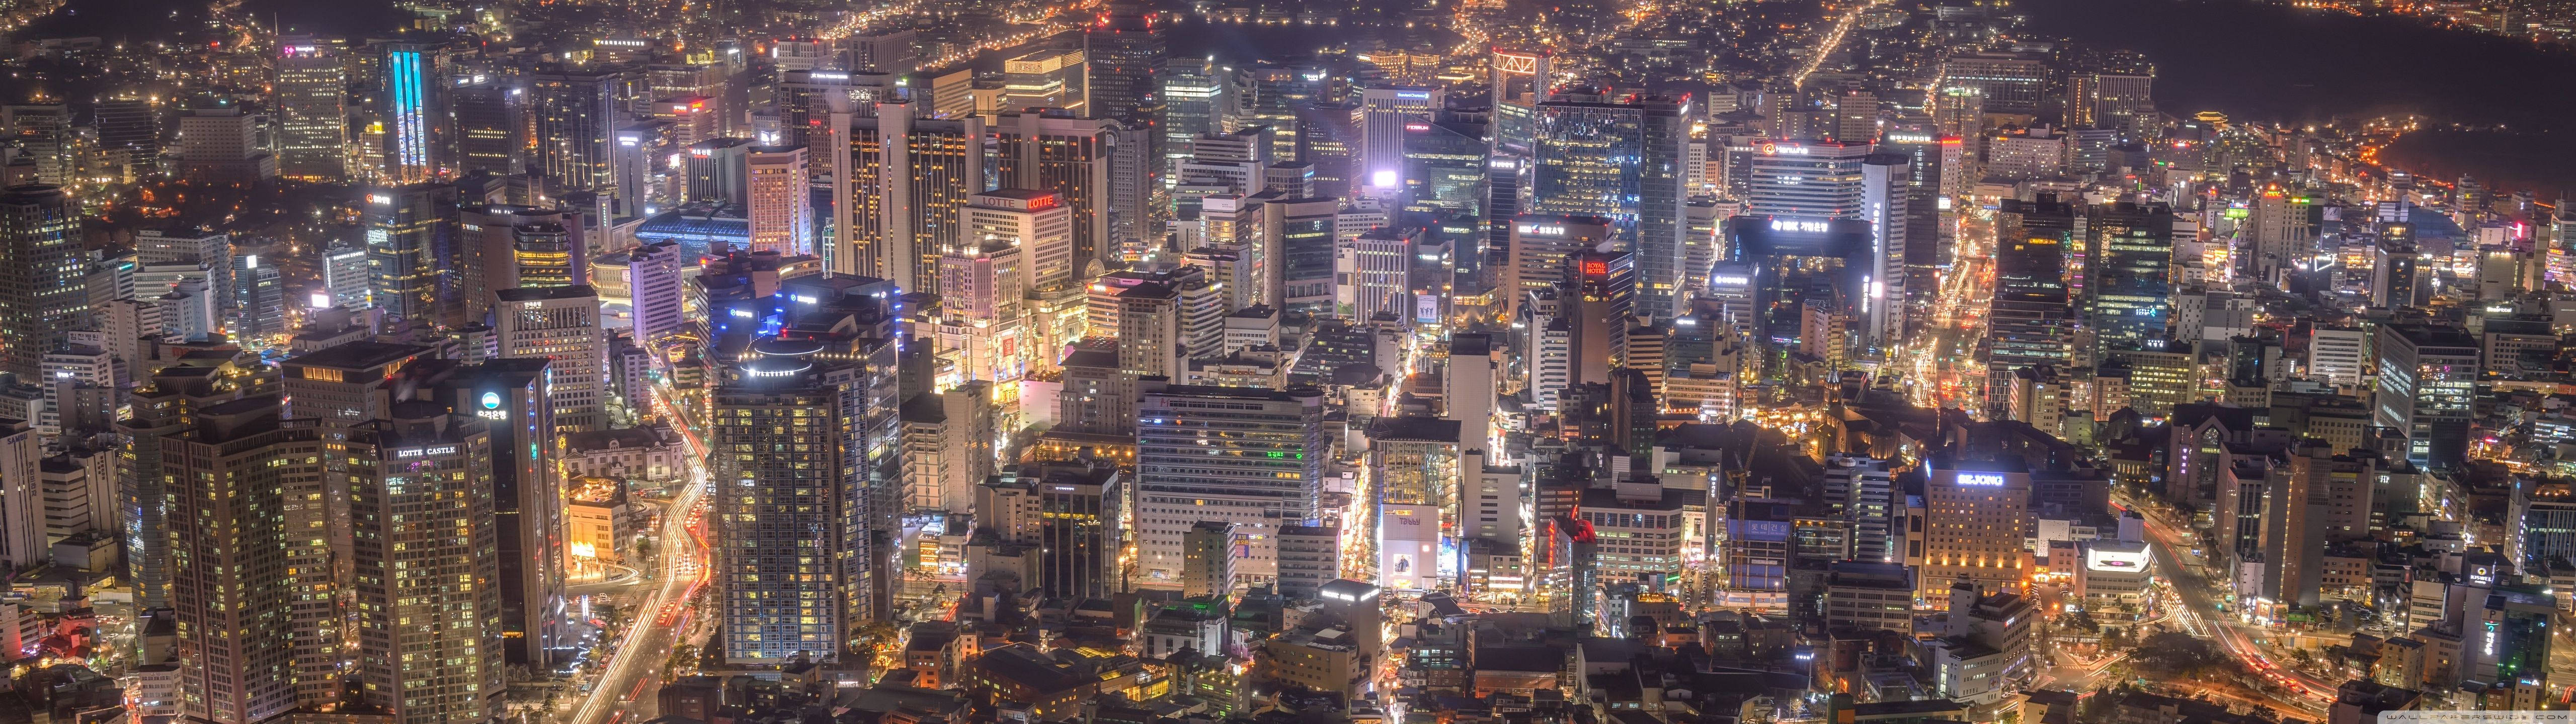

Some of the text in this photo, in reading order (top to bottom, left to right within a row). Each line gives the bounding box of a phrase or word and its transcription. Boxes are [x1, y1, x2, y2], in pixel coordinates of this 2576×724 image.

[1775, 145, 1808, 154] Hanwha
[983, 197, 1015, 208] LOTTE
[1028, 195, 1053, 209] LOTTE
[70, 333, 99, 342] 힘찬병원
[478, 410, 507, 420] 우리은행
[7, 432, 28, 445] SAMBU
[427, 446, 456, 455] CASTLE
[1957, 474, 2003, 486] SEJONG
[2489, 610, 2496, 618] P
